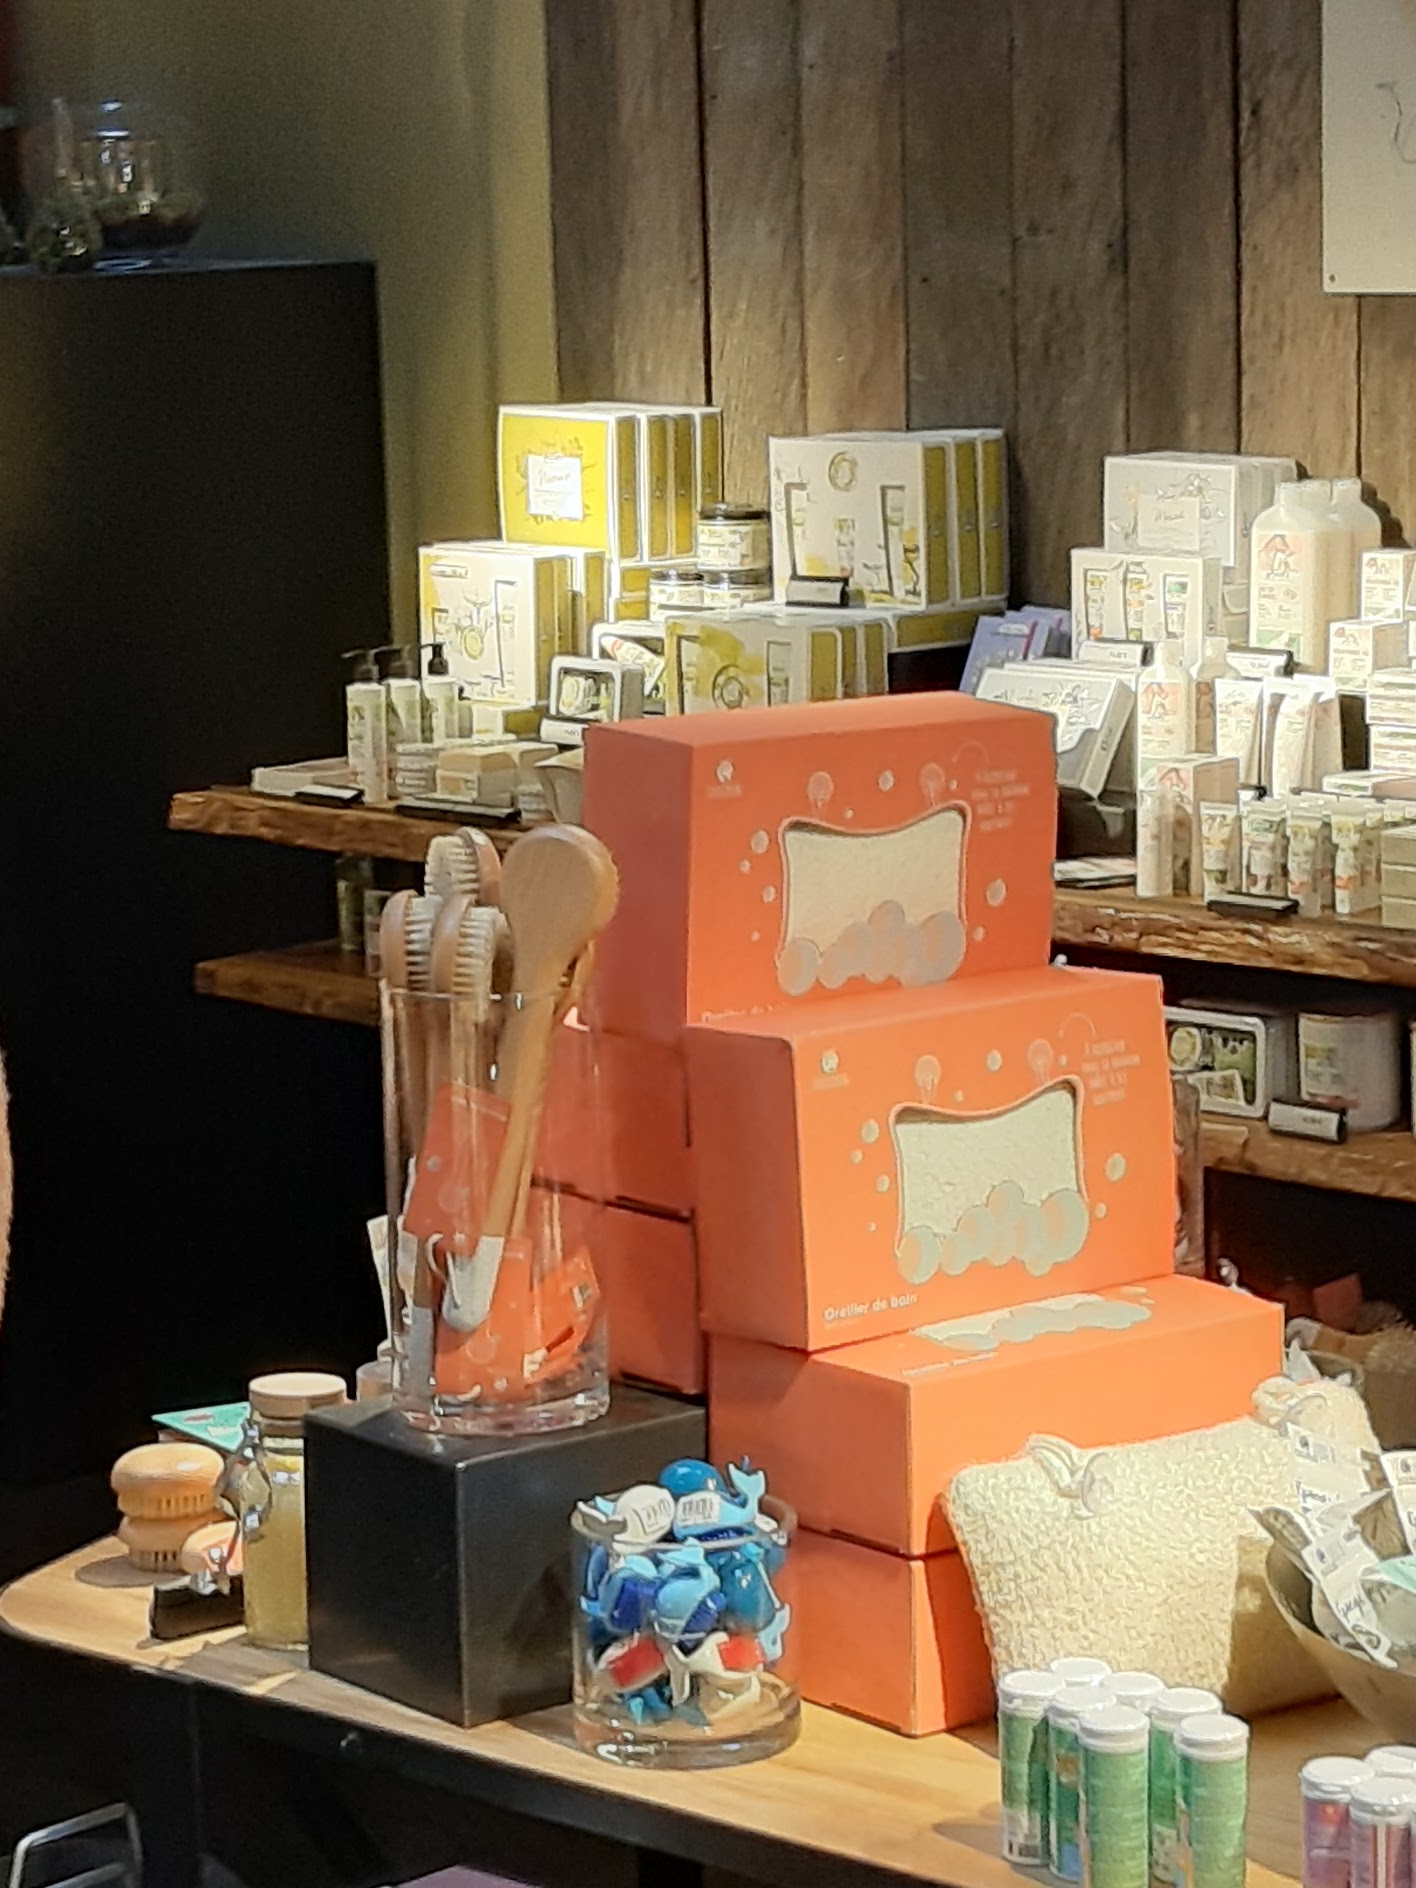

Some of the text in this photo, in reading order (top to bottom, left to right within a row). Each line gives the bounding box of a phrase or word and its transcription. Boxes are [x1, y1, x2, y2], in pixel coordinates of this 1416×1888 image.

[823, 1292, 919, 1322] Oreiller de bain
